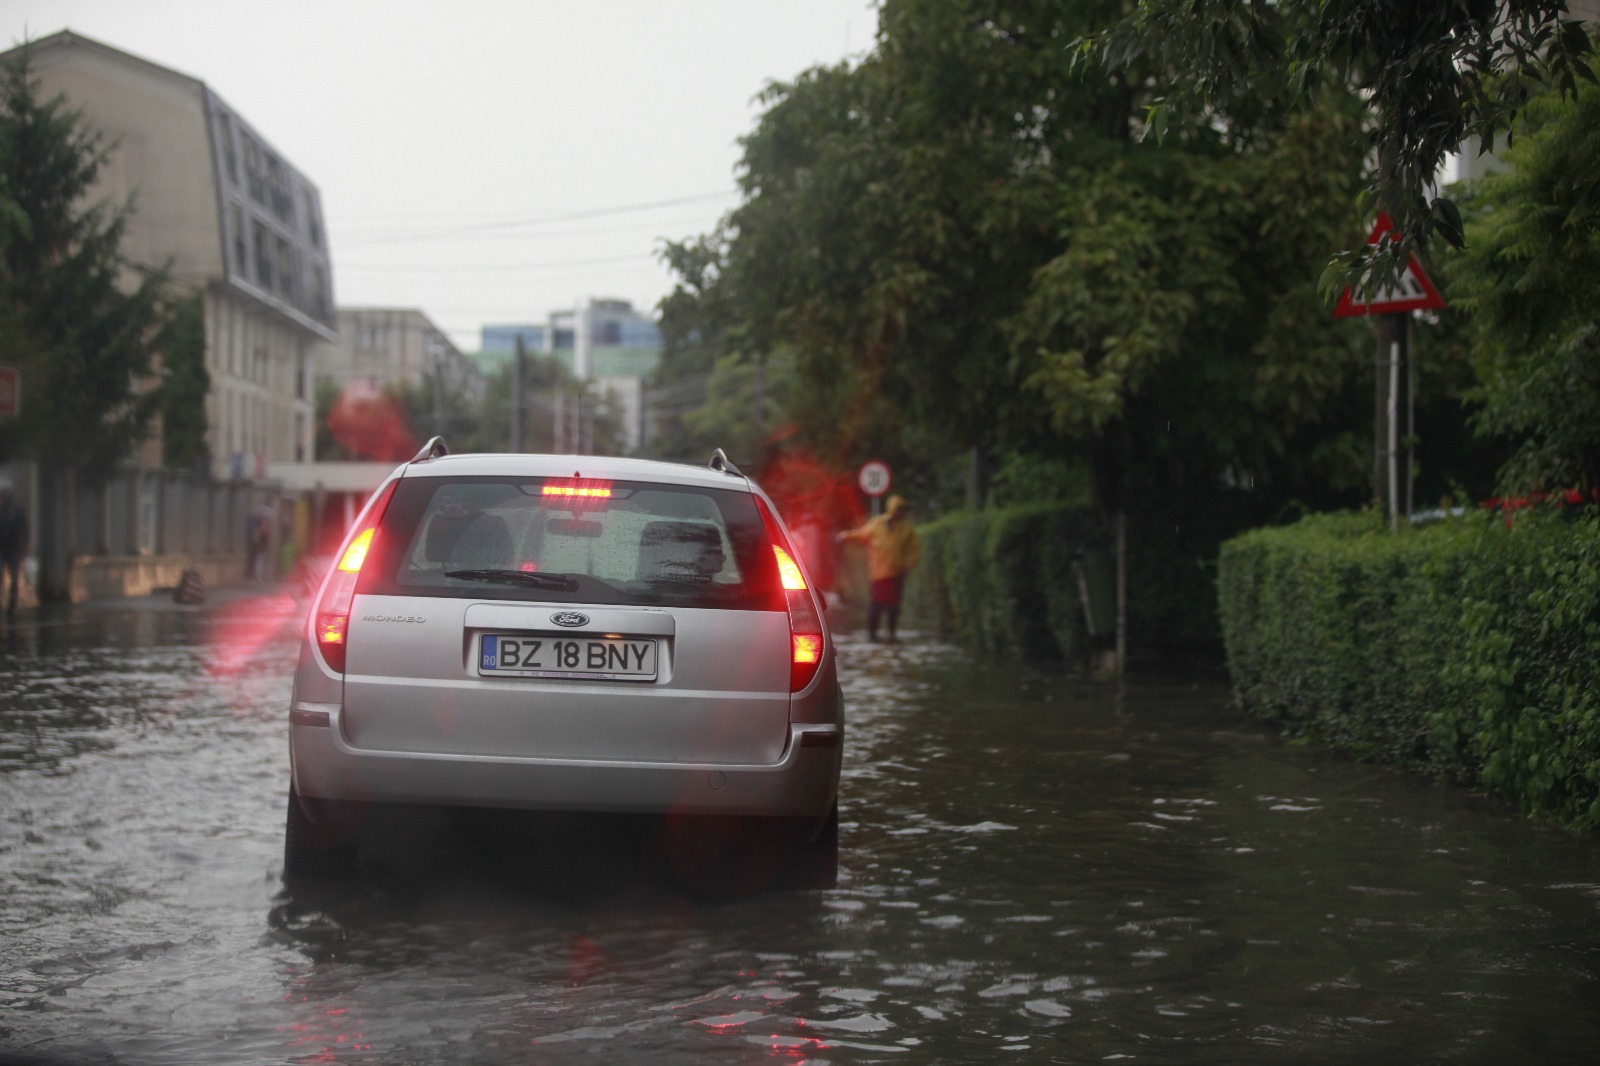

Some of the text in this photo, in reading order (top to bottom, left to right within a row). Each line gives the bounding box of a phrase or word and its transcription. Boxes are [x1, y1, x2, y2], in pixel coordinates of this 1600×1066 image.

[362, 614, 426, 624] MONDEO
[559, 614, 580, 624] Ford
[500, 640, 650, 670] BZ 18 BNY
[483, 655, 496, 666] RO
